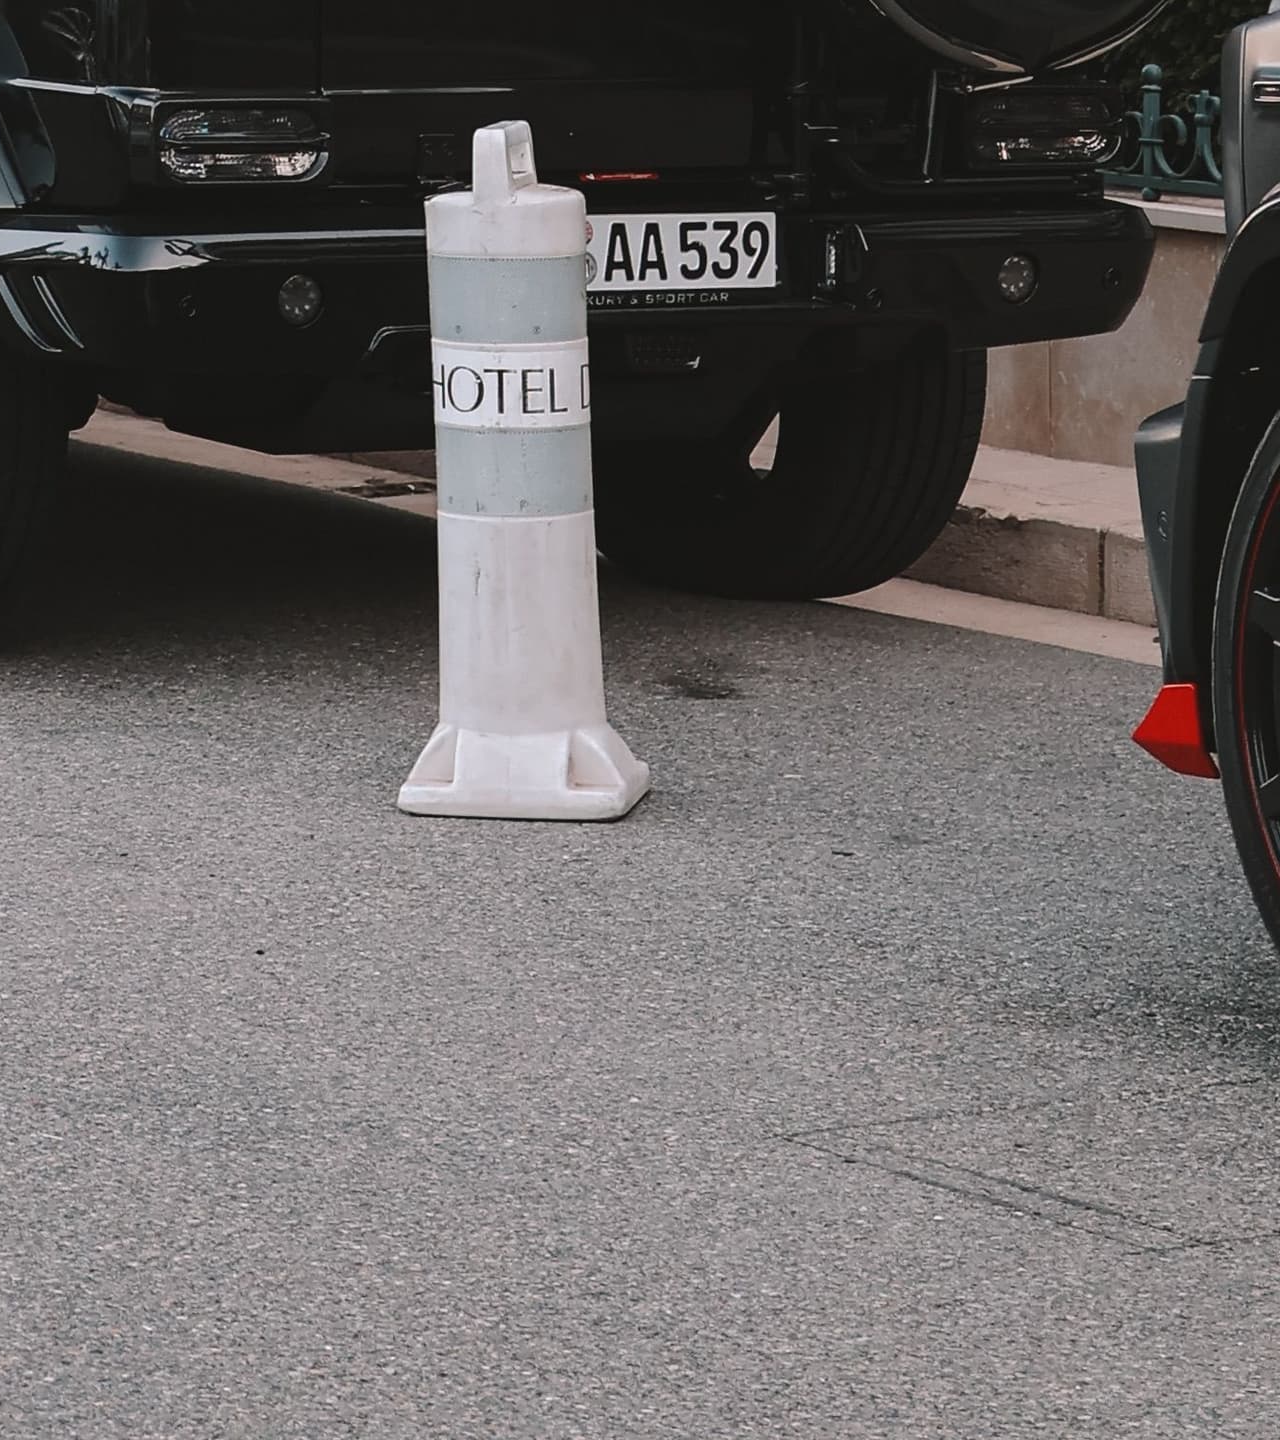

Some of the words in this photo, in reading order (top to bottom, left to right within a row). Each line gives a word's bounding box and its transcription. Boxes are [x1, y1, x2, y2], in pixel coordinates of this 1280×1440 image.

[603, 221, 669, 282] AA
[678, 220, 771, 281] 539
[645, 292, 695, 305] SPORT
[699, 292, 730, 303] CAR
